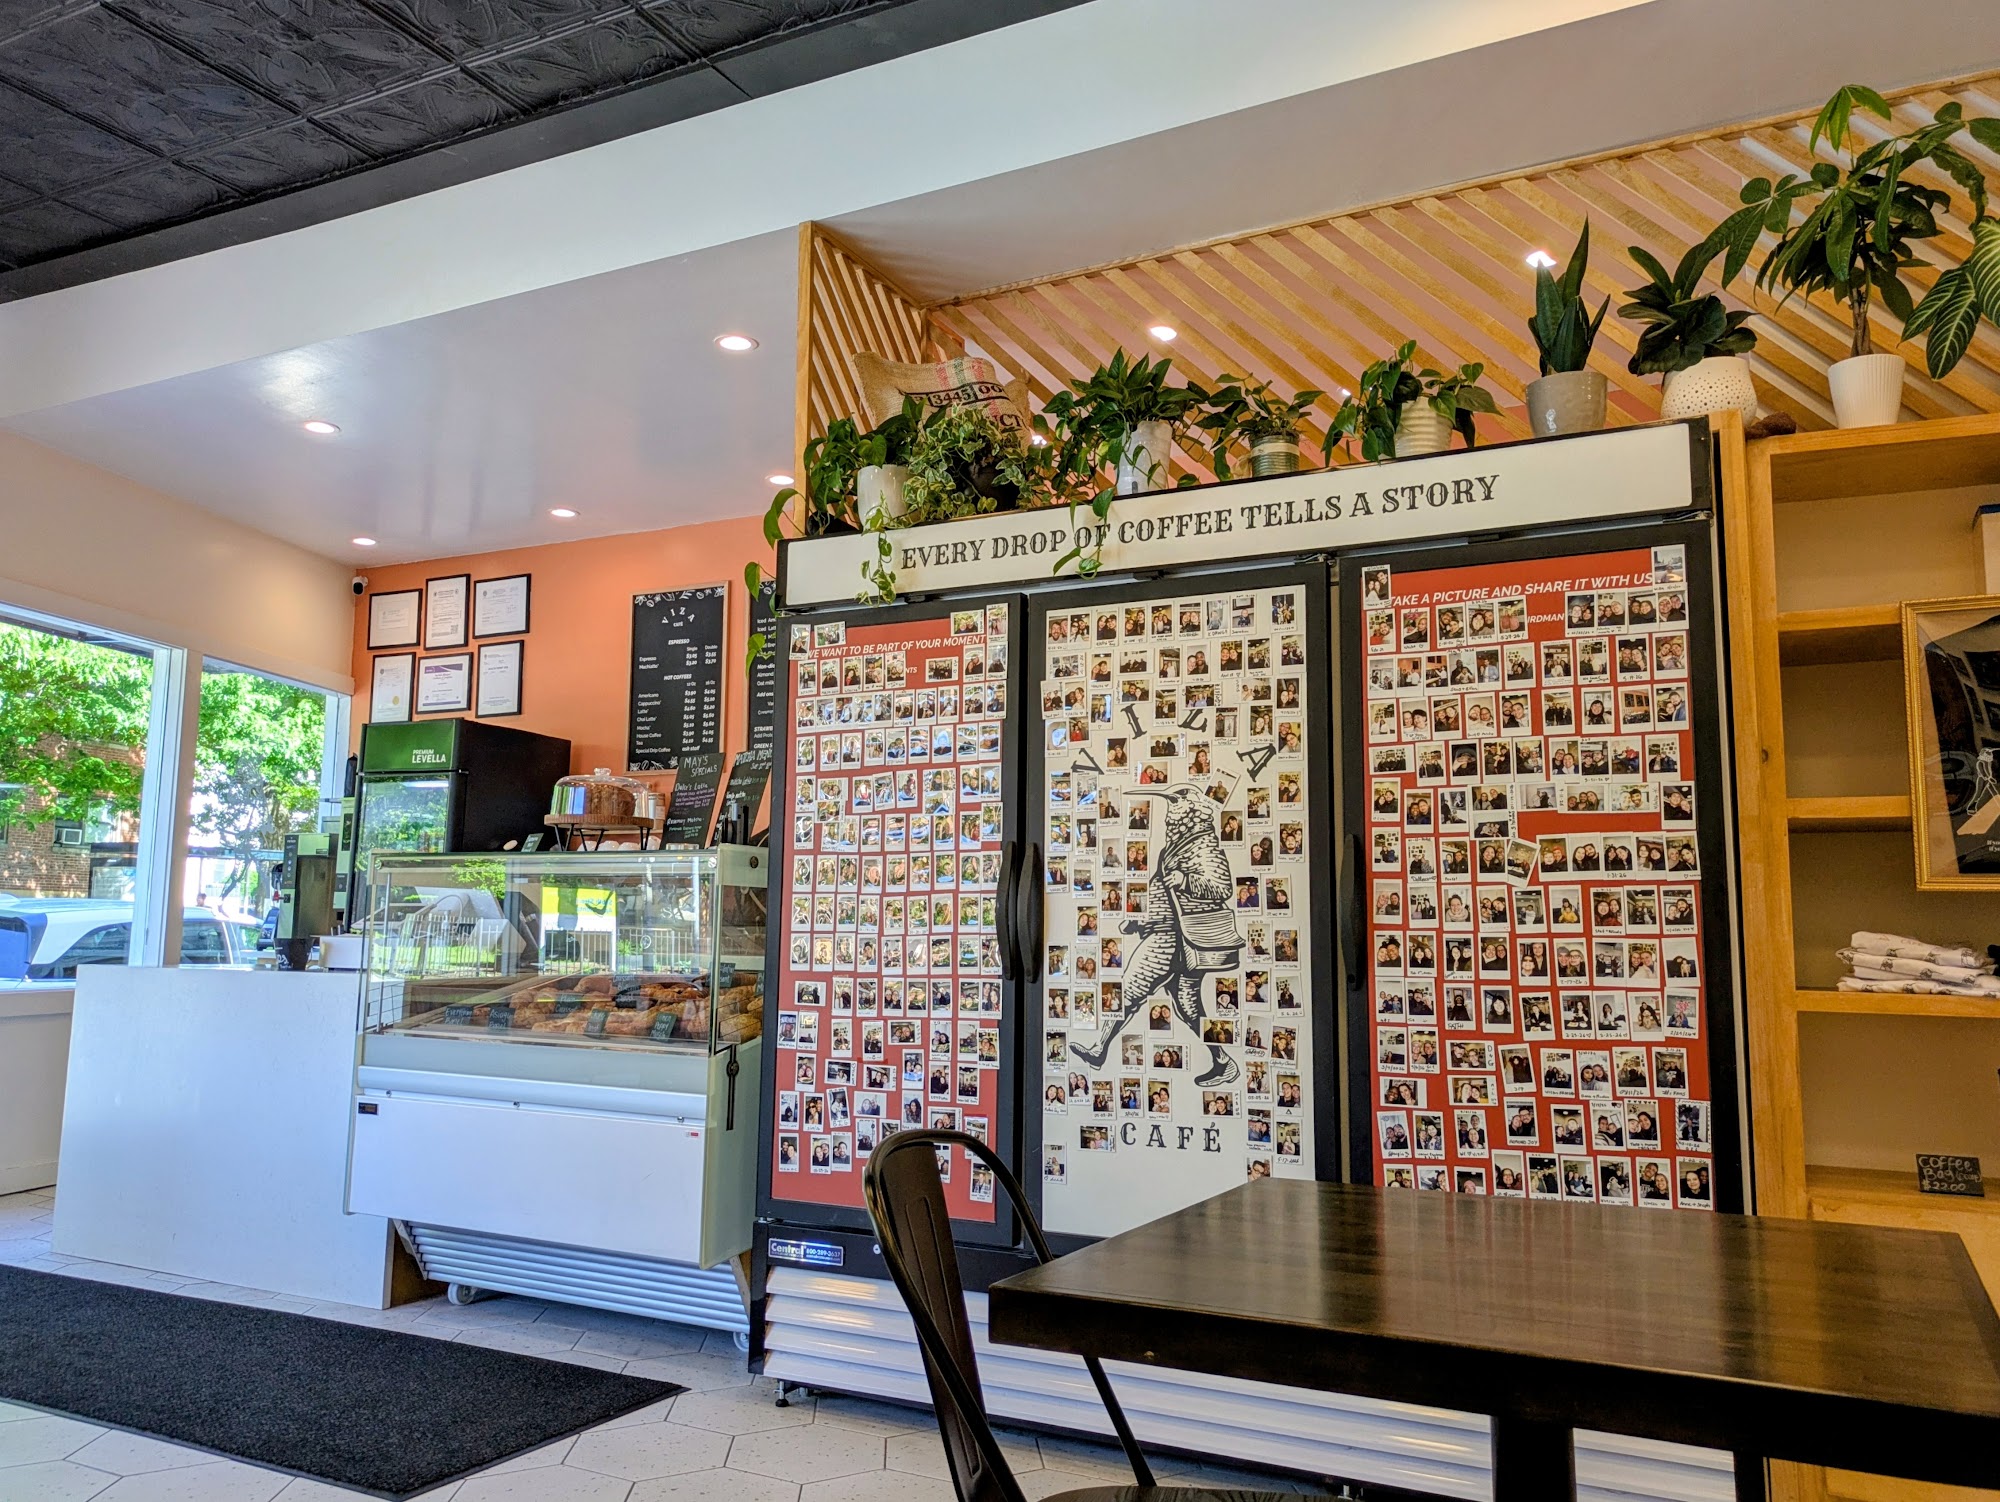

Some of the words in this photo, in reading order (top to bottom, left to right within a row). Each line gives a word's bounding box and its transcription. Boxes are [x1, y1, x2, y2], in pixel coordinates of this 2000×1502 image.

[932, 389, 971, 405] 3445
[901, 539, 986, 570] EVERY
[991, 529, 1066, 559] DROP
[1074, 523, 1111, 549] OF
[1118, 508, 1233, 544] COFFEE
[1241, 495, 1342, 530] TELLS
[1349, 492, 1374, 517] A
[1382, 474, 1500, 514] STORY
[1390, 594, 1419, 607] TAKE
[1421, 593, 1430, 604] A
[1433, 588, 1486, 602] PICTURE
[1491, 584, 1521, 597] AND
[1524, 580, 1572, 594] SHARE
[1574, 578, 1589, 590] IT
[1591, 574, 1630, 589] WITH
[1633, 573, 1653, 585] US
[662, 606, 695, 624] VIZA
[821, 646, 849, 658] WANT
[849, 645, 862, 656] TO
[864, 644, 875, 655] BE
[877, 641, 901, 654] PART
[901, 640, 914, 651] OF
[915, 638, 941, 650] YOUR
[942, 634, 986, 648] MOMENT
[412, 753, 447, 764] LEVELLA
[684, 755, 709, 769] MAY'S
[691, 764, 718, 777] SPECIALS
[1120, 1121, 1221, 1153] CAFÉ
[1923, 1167, 1954, 1183] Bag
[771, 1243, 804, 1257] Central
